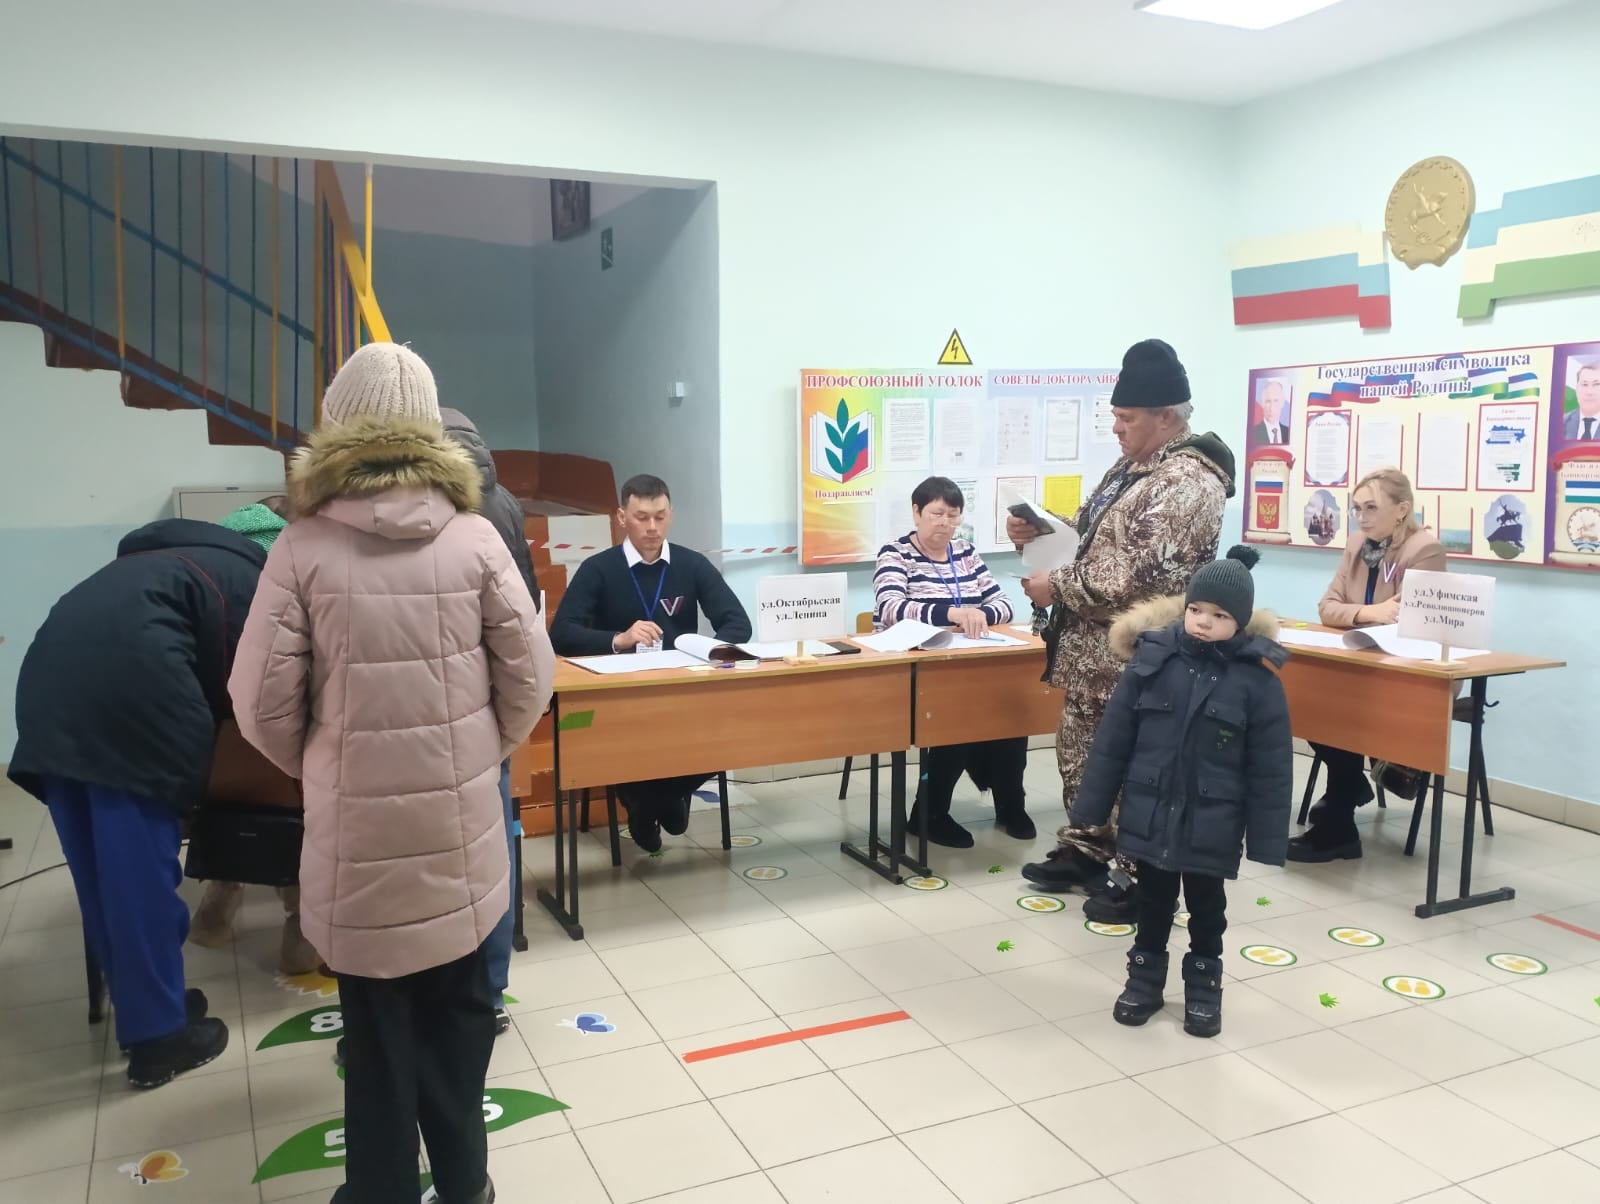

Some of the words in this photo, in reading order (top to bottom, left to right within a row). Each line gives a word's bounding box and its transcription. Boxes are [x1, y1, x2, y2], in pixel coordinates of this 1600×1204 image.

[1317, 359, 1436, 381] Государственная
[1442, 354, 1531, 371] символика
[806, 373, 924, 388] ПРОФСОЮЗНЫЙ
[928, 375, 983, 388] УГОЛОК
[994, 375, 1041, 385] СОВЕТЫ
[1043, 375, 1092, 385] ДОКТОРА
[1360, 380, 1408, 397] нашей
[1413, 380, 1472, 397] Родины
[816, 488, 873, 500] Поздравляем!
[1413, 588, 1478, 603] ул.Уфимская
[761, 597, 841, 611] ул.Октябрьская
[776, 610, 827, 623] ул.Ленина
[1424, 614, 1465, 629] ул.Мира
[310, 1011, 344, 1033] 8
